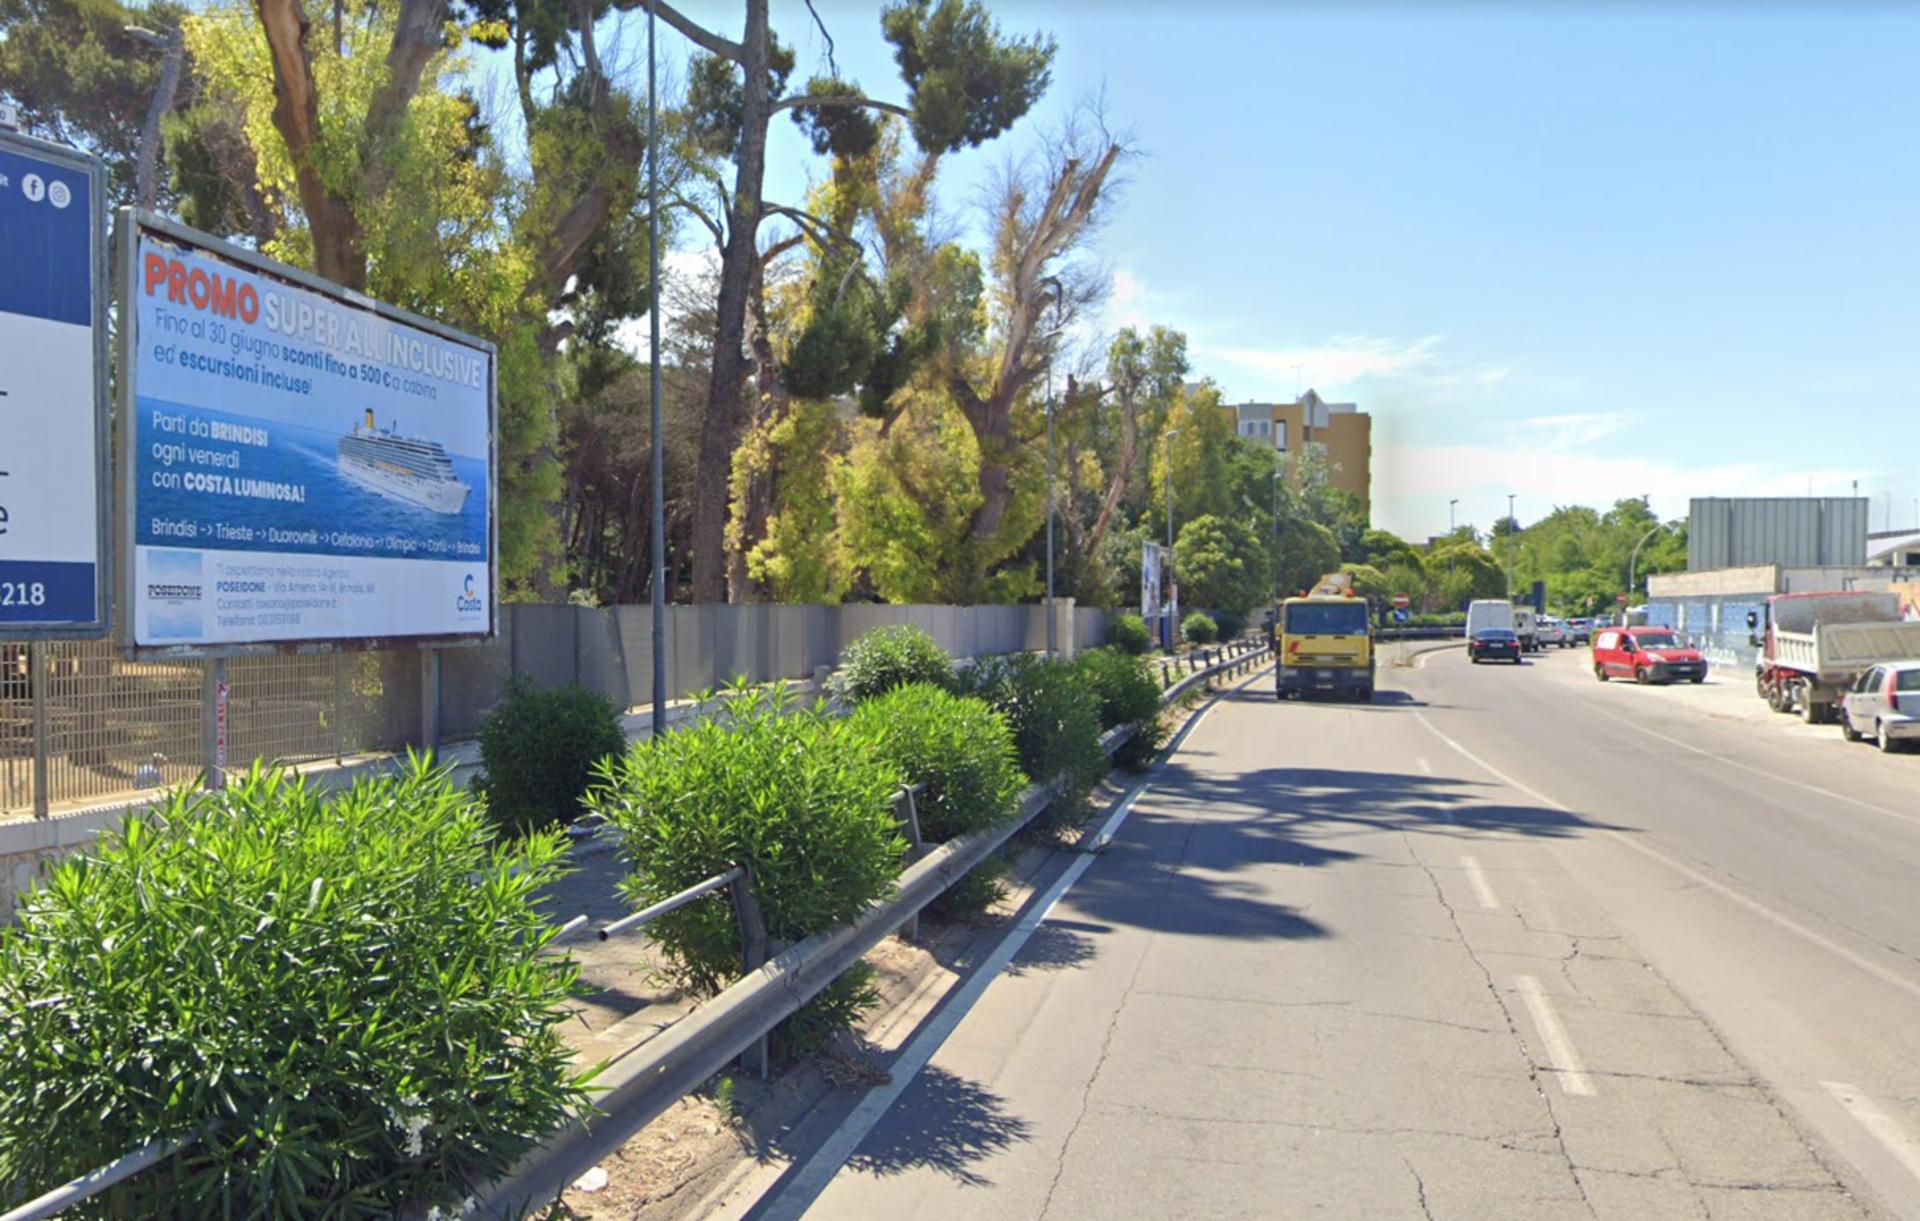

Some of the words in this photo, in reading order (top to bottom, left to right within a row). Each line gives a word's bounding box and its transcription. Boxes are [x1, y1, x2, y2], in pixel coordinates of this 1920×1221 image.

[145, 252, 259, 325] PROMO
[264, 291, 341, 351] SUPER
[344, 317, 384, 363] ALL
[387, 330, 482, 391] INCLUSIVE
[153, 343, 176, 365] ed
[179, 349, 259, 384] escursioni
[155, 307, 188, 335] Fino
[191, 320, 206, 339] al
[209, 321, 226, 345] 30
[230, 329, 280, 361] giugno
[281, 345, 323, 370] sconti
[324, 352, 346, 377] fino
[349, 365, 358, 380] a
[360, 364, 381, 385] 500
[392, 377, 401, 391] a
[152, 410, 186, 433] Parti
[189, 416, 209, 438] da
[210, 421, 269, 447] BRINDISI
[151, 442, 186, 467] ogni
[188, 447, 240, 470] venerdì
[152, 471, 181, 489] con
[183, 471, 233, 495] COSTA
[234, 477, 306, 503] LUMINOSA!
[151, 518, 198, 538] Brindisi
[215, 522, 254, 541] Trieste
[268, 526, 319, 545] Dubrovnik
[148, 584, 202, 597] POSEIDONE
[217, 581, 266, 593] POSEIDONE
